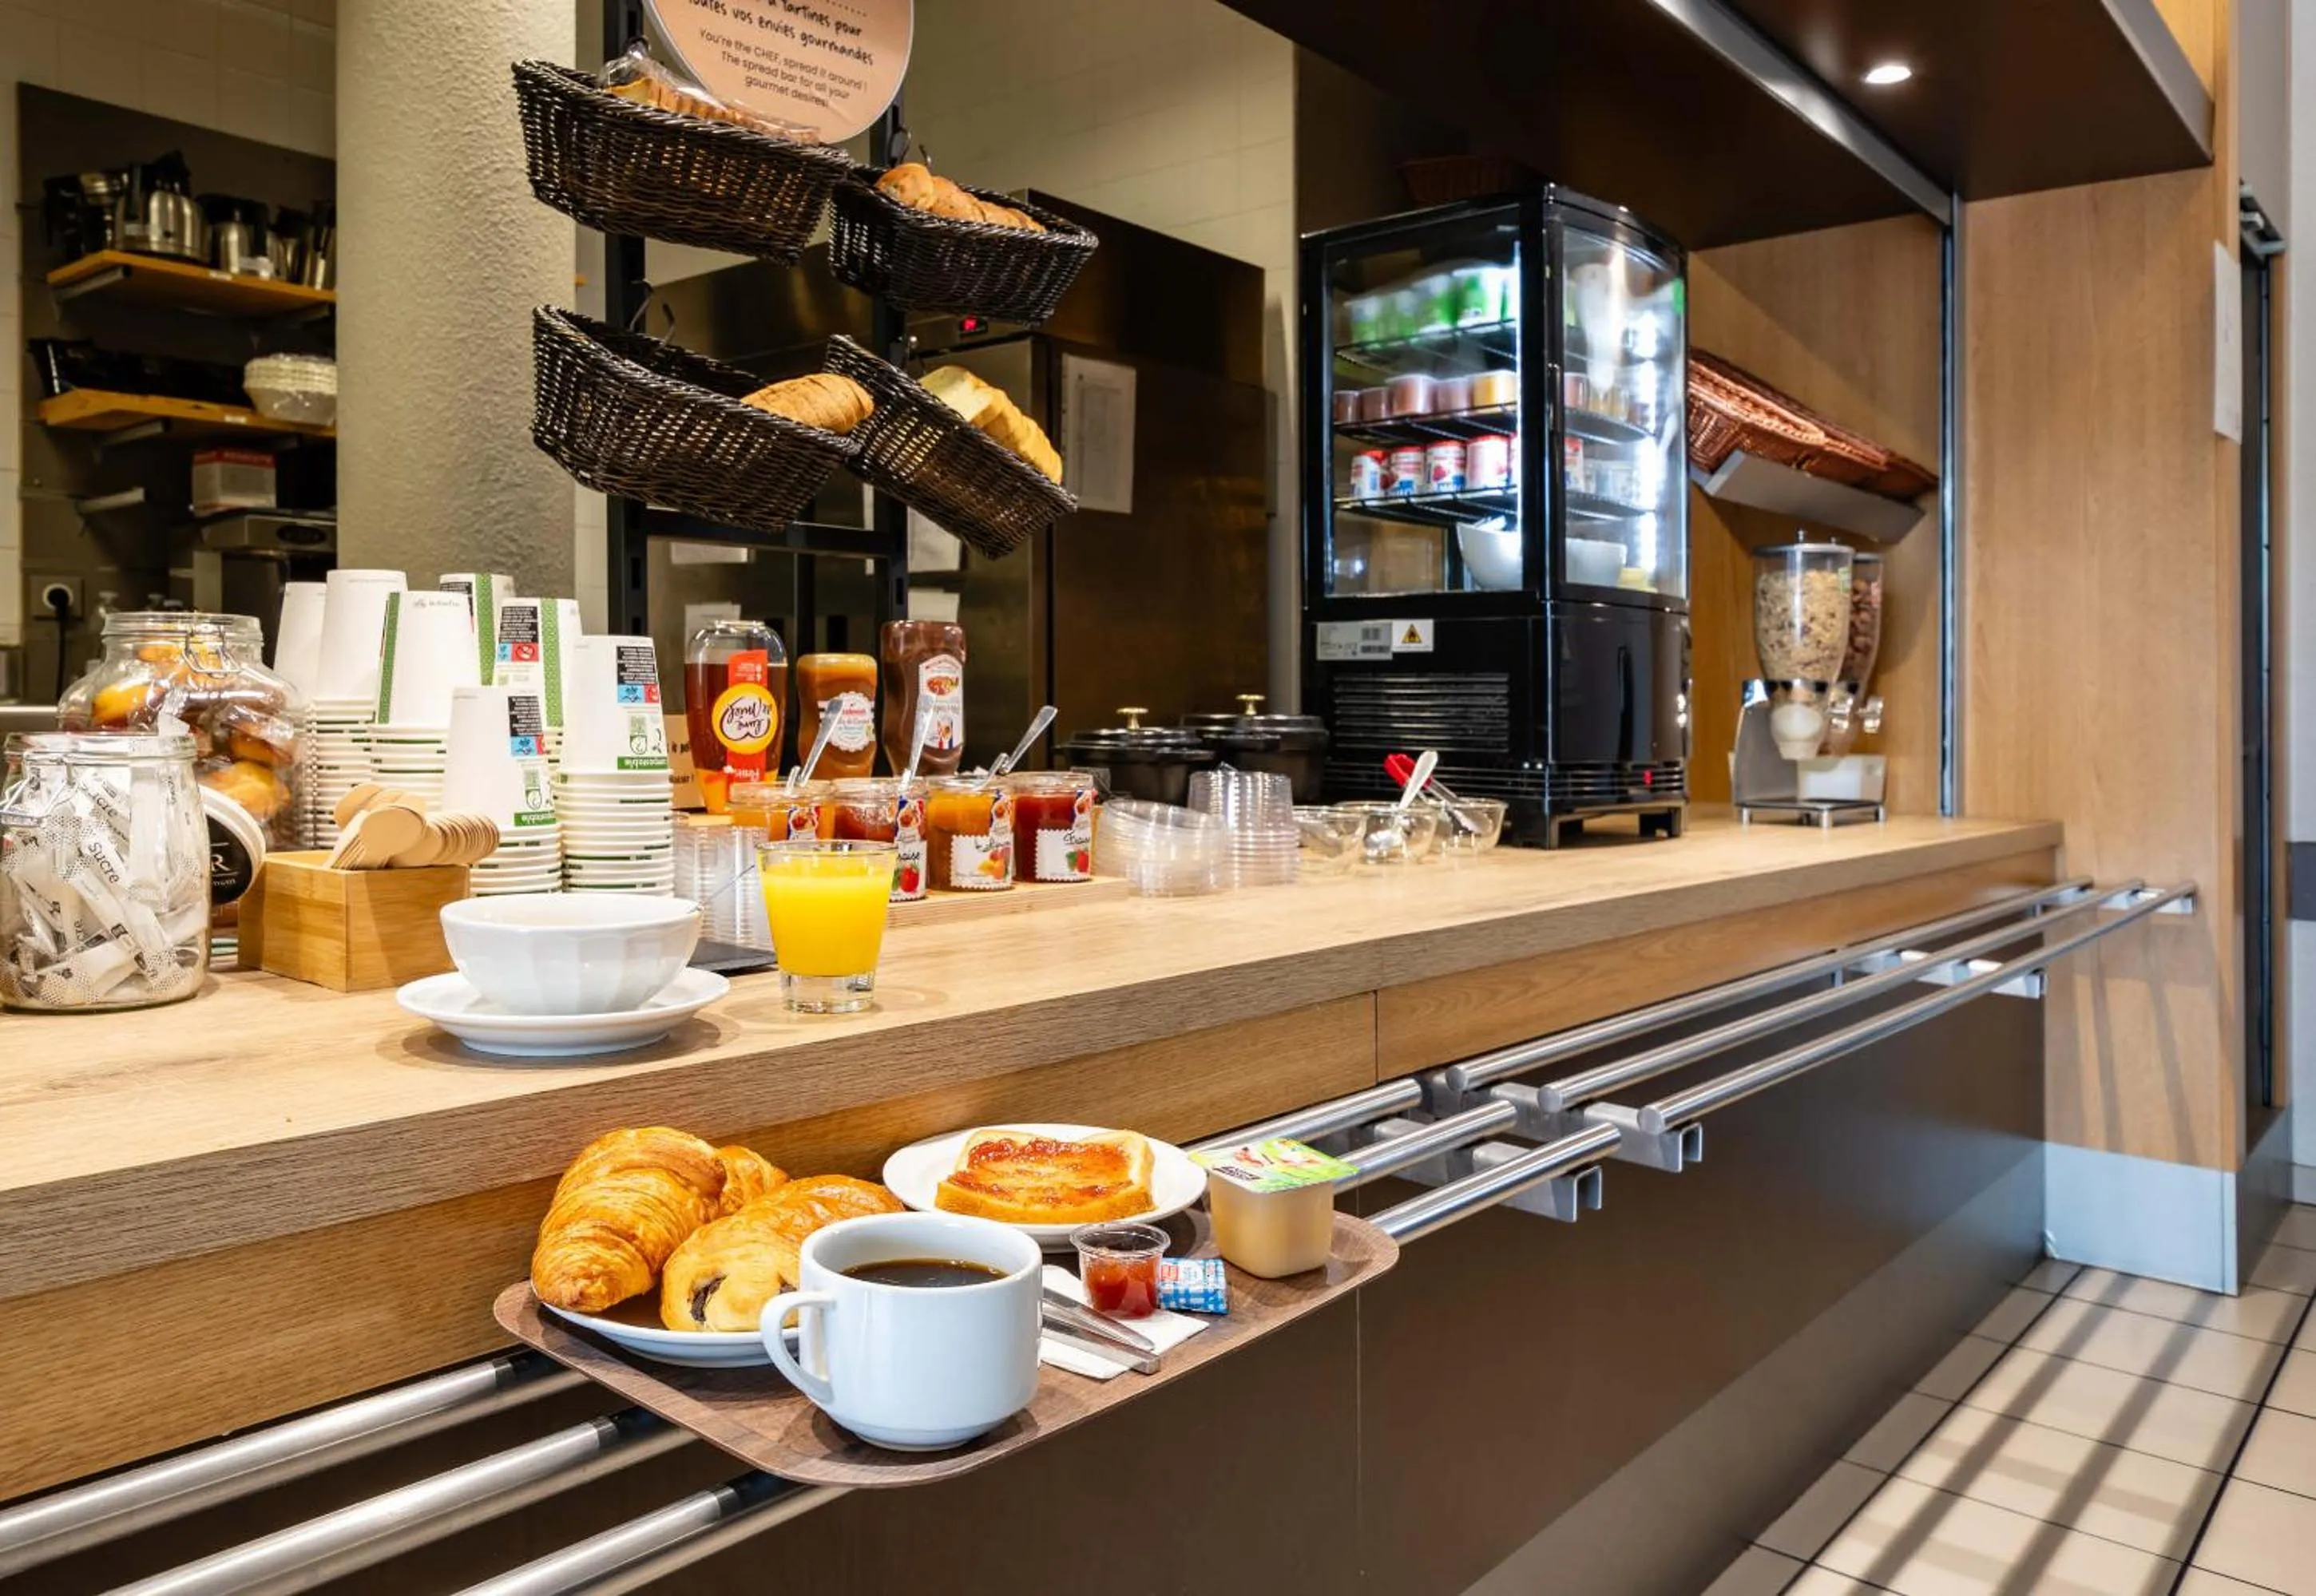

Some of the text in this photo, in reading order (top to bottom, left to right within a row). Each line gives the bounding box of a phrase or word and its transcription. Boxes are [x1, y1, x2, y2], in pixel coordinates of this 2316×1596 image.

[732, 8, 753, 24] vos
[758, 15, 795, 39] envies
[801, 32, 873, 65] gourmandes
[835, 21, 863, 36] pour
[700, 27, 732, 48] You're
[735, 40, 752, 53] the
[783, 57, 818, 75] spread
[828, 72, 863, 90] around
[722, 50, 740, 65] The
[742, 59, 779, 78] spread
[781, 69, 798, 83] bar
[829, 86, 851, 100] your
[745, 76, 789, 97] gourmet
[88, 842, 119, 883] Sucre
